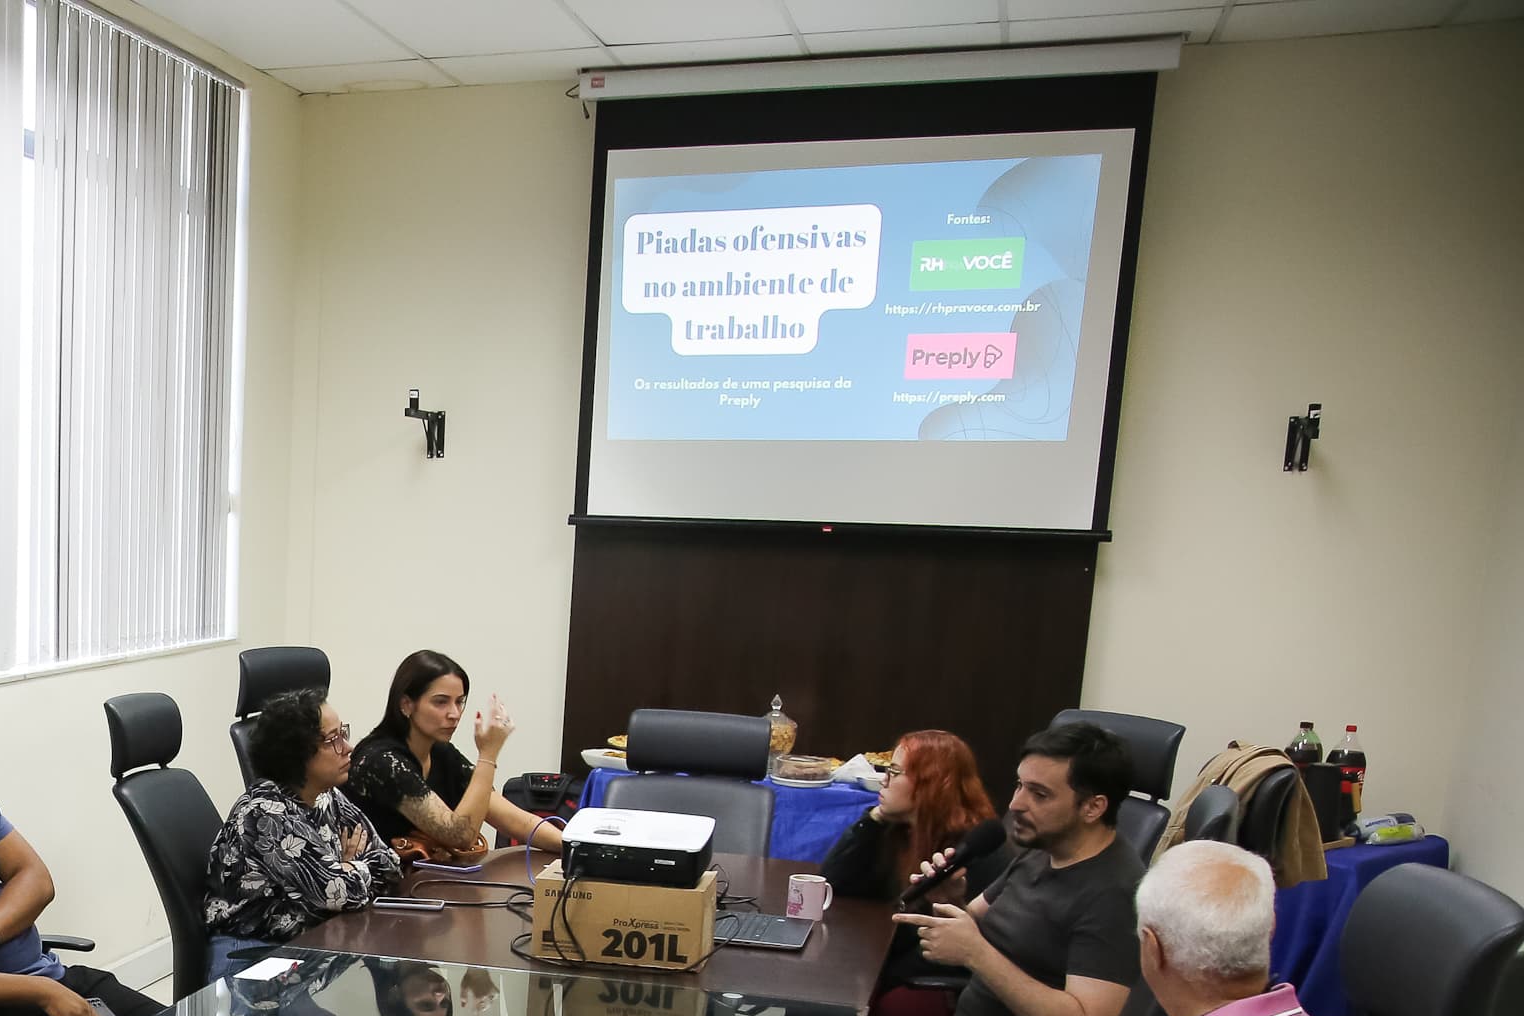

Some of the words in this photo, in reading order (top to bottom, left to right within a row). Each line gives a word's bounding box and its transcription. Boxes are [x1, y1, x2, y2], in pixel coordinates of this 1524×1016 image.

[947, 213, 991, 225] Fontes:
[636, 228, 727, 255] Piadas
[732, 224, 867, 251] ofensivas
[920, 257, 944, 272] RH
[962, 251, 1013, 271] VOCÊ
[643, 281, 677, 298] no
[681, 271, 814, 297] ambiente
[820, 268, 854, 294] de
[884, 300, 1042, 318] https://rhpravoce.com.br
[684, 314, 806, 341] trabalho
[912, 347, 981, 369] Preply
[634, 378, 651, 391] Os
[653, 377, 720, 391] resultados
[722, 377, 740, 390] de
[741, 379, 771, 390] uma
[772, 376, 831, 393] pesquisa
[834, 376, 852, 390] da
[719, 394, 762, 409] Preply
[892, 391, 1006, 405] https://preply.com
[601, 928, 688, 964] 201L
